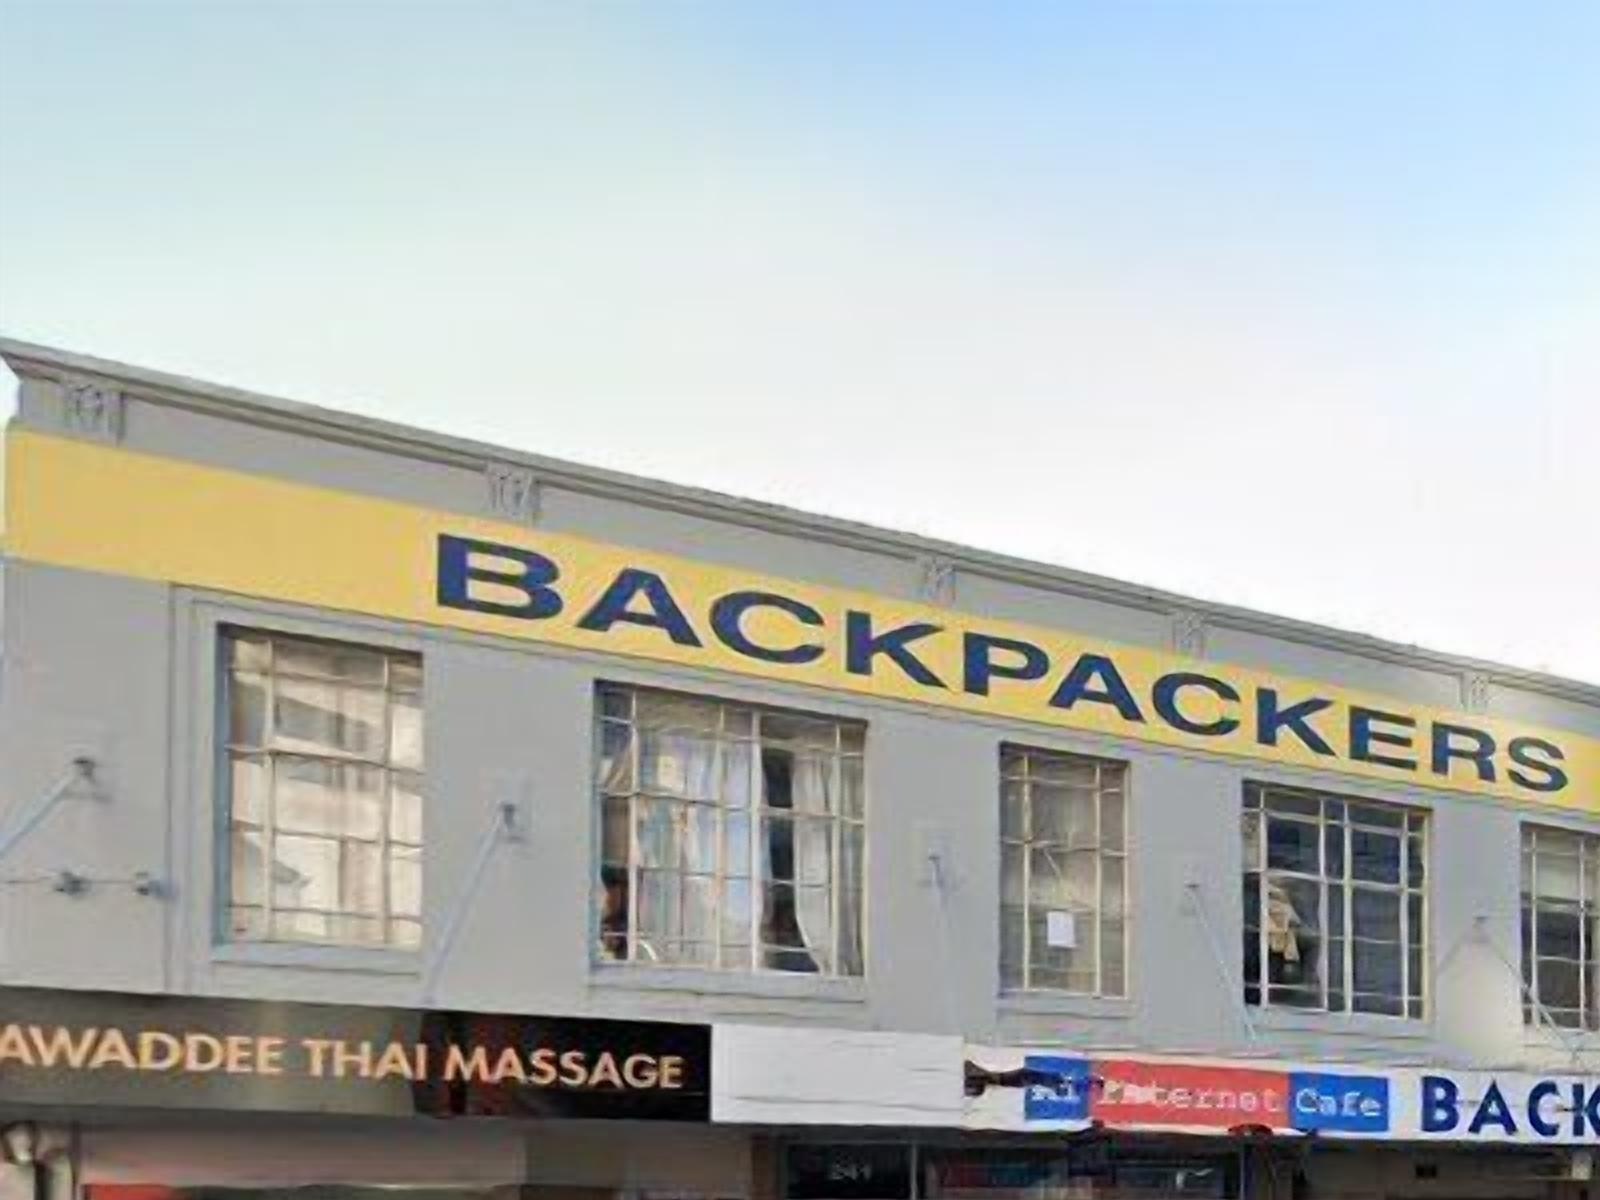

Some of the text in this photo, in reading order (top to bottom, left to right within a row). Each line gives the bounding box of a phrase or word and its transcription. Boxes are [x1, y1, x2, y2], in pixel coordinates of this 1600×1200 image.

[437, 533, 1569, 792] BACKPACKERS
[0, 1023, 686, 1090] AWADDEE THAI MASSAGE
[1096, 1080, 1285, 1114] Iternet
[1295, 1086, 1382, 1118] Cafe
